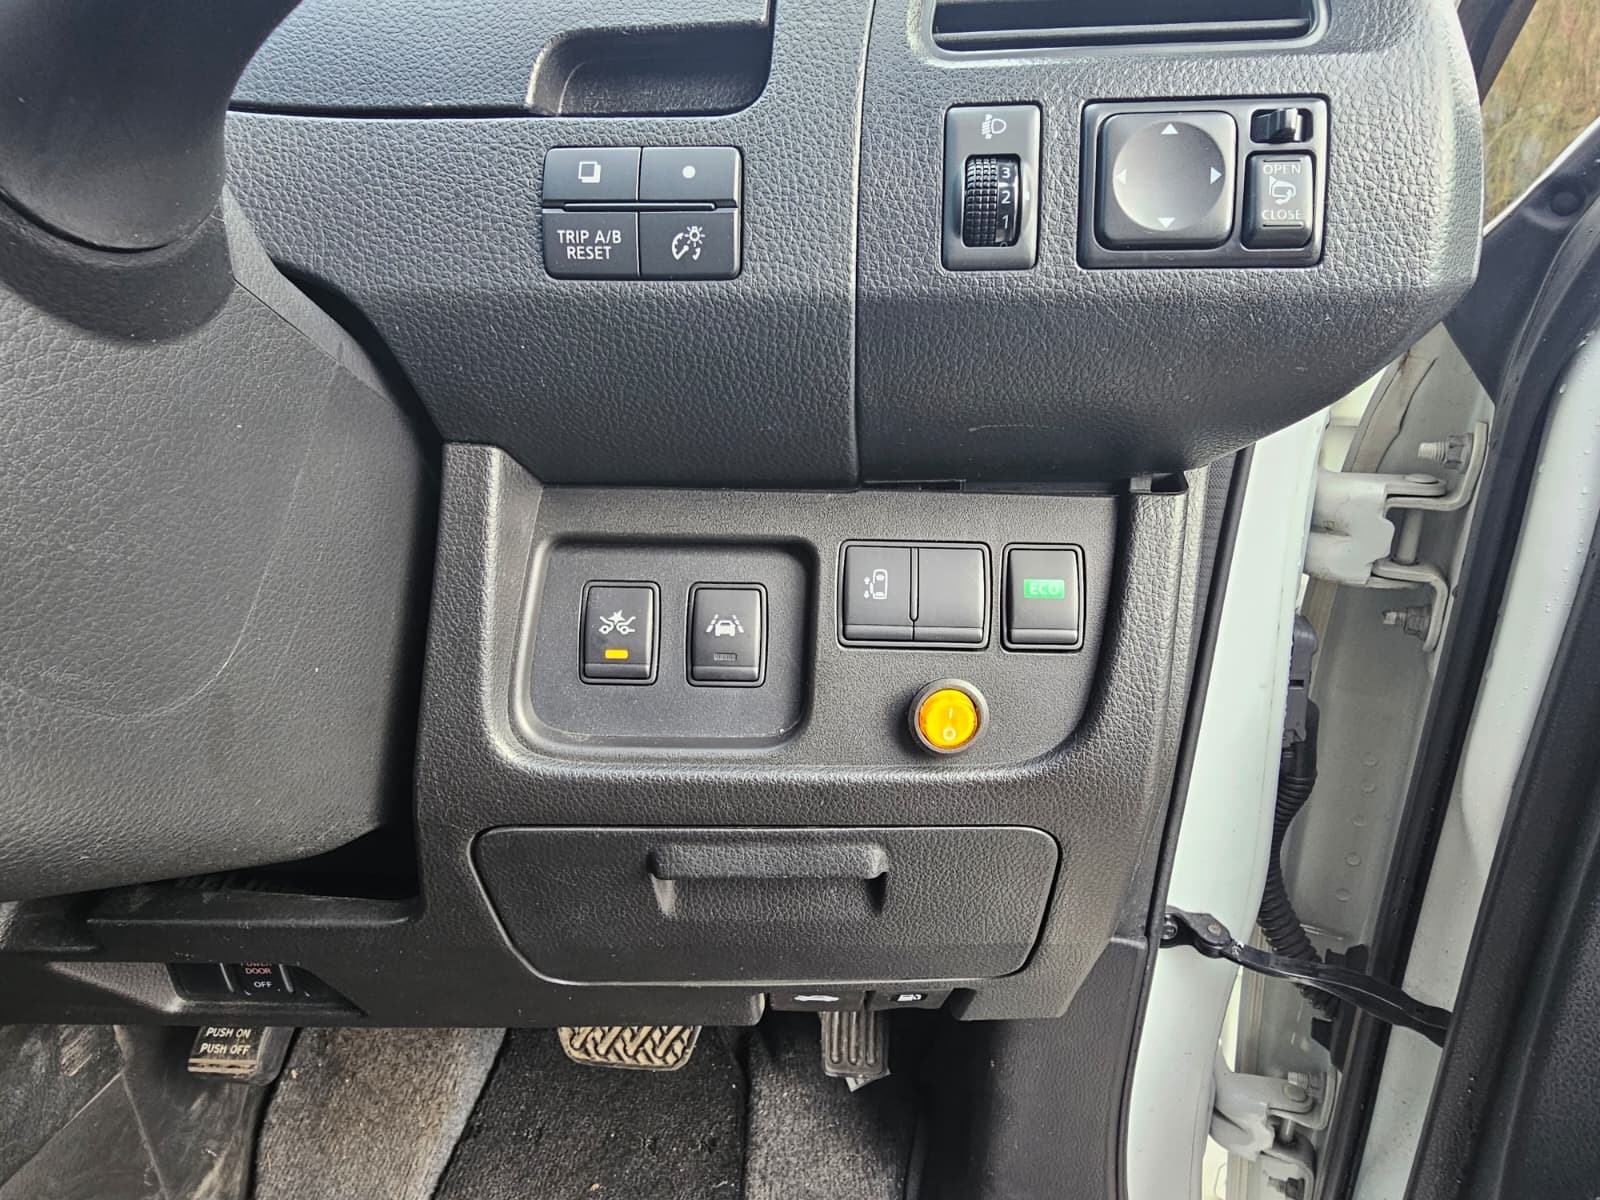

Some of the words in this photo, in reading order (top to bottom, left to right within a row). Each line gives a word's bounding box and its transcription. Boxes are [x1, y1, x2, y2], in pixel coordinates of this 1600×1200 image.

[1001, 167, 1011, 179] 3
[1262, 164, 1302, 175] OPEN
[1001, 191, 1011, 204] 2
[1261, 208, 1302, 221] CLOSE
[1002, 215, 1009, 229] 1
[557, 230, 590, 244] TRIP
[594, 230, 622, 243] A/B
[567, 246, 612, 260] RESET
[1030, 583, 1060, 596] ECO
[245, 967, 272, 975] DOOR
[206, 1027, 233, 1038] PUSH
[235, 1028, 251, 1039] ON
[200, 1043, 227, 1055] PUSH
[229, 1045, 251, 1055] OFF
